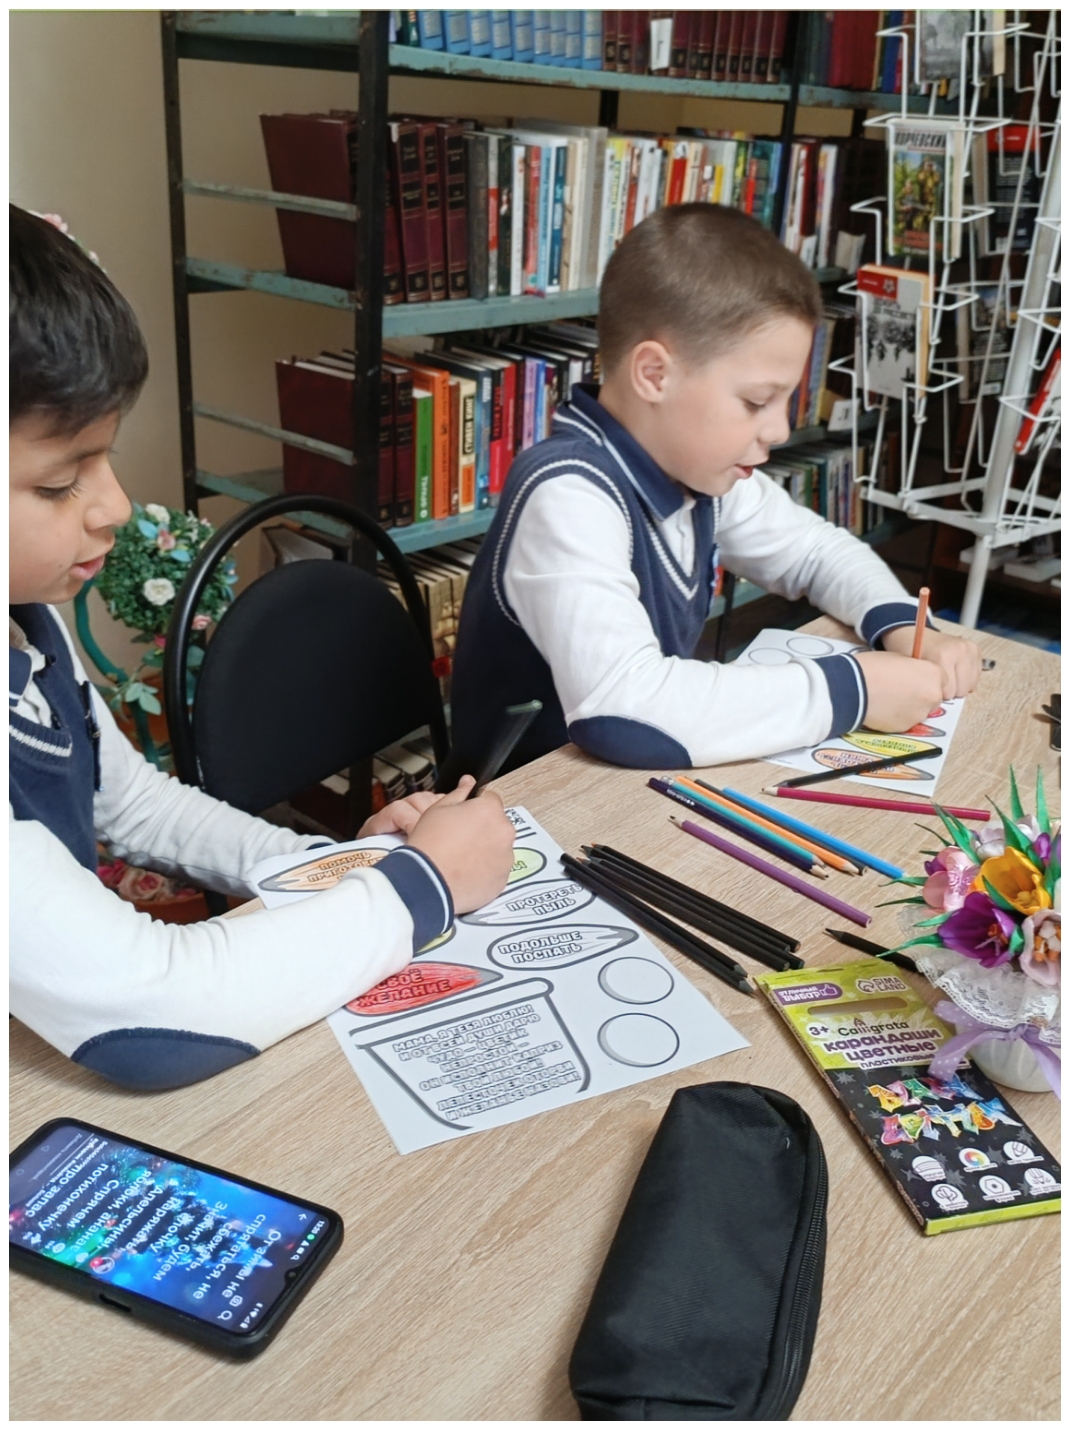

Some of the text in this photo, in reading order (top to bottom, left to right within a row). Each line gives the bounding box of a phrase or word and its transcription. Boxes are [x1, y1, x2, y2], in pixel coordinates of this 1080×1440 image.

[464, 398, 474, 454] СТИВЕН КИНГ
[319, 851, 370, 871] ПОМОЧЬ
[505, 883, 584, 913] ПРОТЕРЕТЬ
[532, 896, 577, 916] ПЫЛЬ
[498, 931, 583, 955] ПОДОЛЬШЕ
[512, 944, 582, 964] ПОСПАТЬ
[359, 979, 452, 1008] ЖЕЛАНИЕ
[378, 969, 424, 990] СВОЁ
[878, 983, 906, 991] LAND
[783, 992, 820, 1002] ВЫБОР
[392, 1004, 535, 1053] МАМА, ТЕБЯ ЛЮБЛЮ!
[433, 1013, 540, 1052] ВСЕЙ ДУШИ ДАРЮ
[809, 1025, 829, 1035] 3+
[823, 1029, 942, 1052] карандаши
[838, 1018, 909, 1036] Calligrata
[427, 1028, 529, 1064] ЧУДО ЦВЕТИК
[440, 1042, 517, 1073] НЕПРОСТОЙ
[846, 1041, 936, 1062] цветные
[860, 1053, 935, 1068] пластиковые
[440, 1041, 563, 1087] ИСПОЛНИТ КАПРИЗ
[452, 1058, 544, 1092] ТВОЙ ЛЮБОЙ!
[436, 1061, 576, 1111] ЛЕПЕСТОЧЕК ОТОРВИ
[457, 1071, 581, 1118] ЖЕЛАНЬЕ НАЗОВИ!
[59, 1163, 80, 1185] про
[25, 1184, 61, 1218] запас
[38, 1162, 109, 1232] потихонечку
[67, 1179, 120, 1229] Спрячем
[108, 1169, 152, 1210] яблоки,
[97, 1186, 163, 1250] Апельсины,
[153, 1201, 228, 1282] Значит, будем
[185, 1222, 233, 1272] сбежать,
[263, 1230, 281, 1247] От
[193, 1214, 266, 1300] спрятаться, не
[222, 1281, 240, 1299] не
